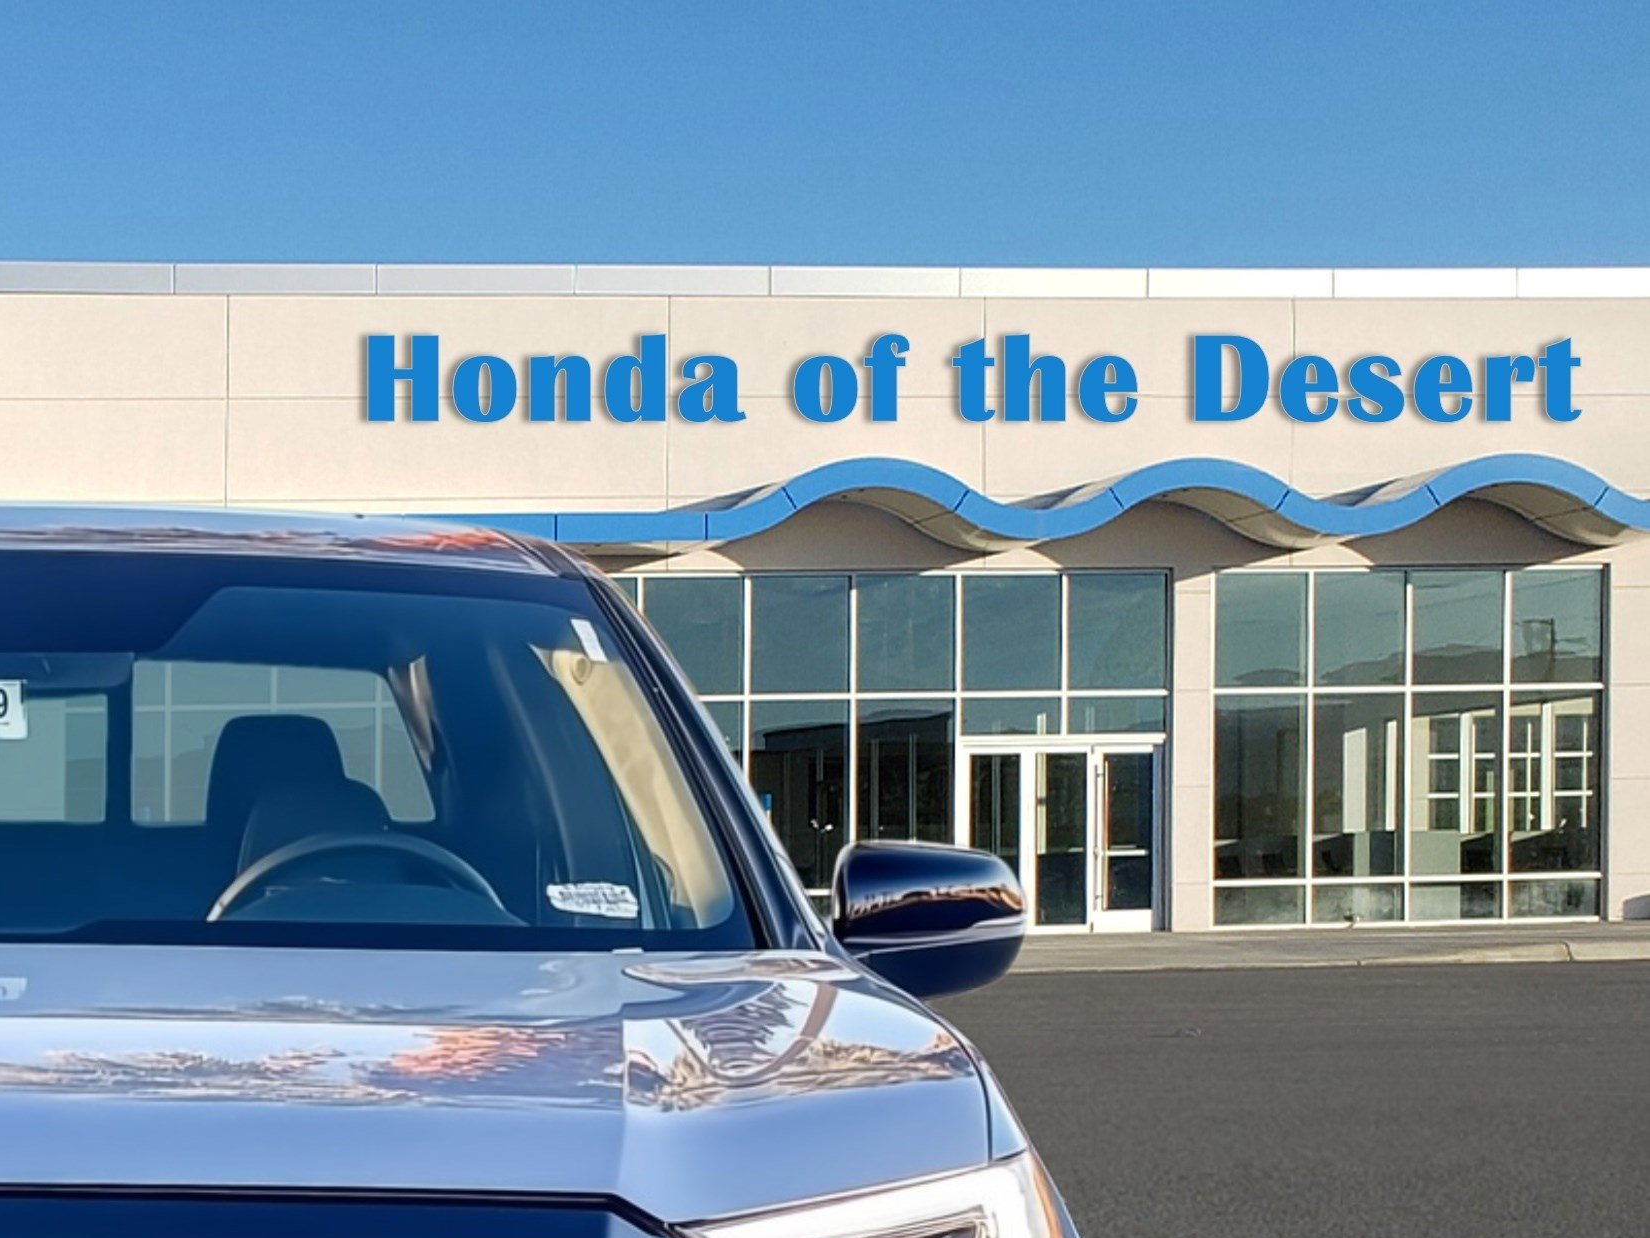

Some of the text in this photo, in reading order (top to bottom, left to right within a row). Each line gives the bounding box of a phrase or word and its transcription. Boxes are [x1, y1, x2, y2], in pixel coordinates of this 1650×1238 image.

[366, 333, 1583, 423] Honda of the Desert
